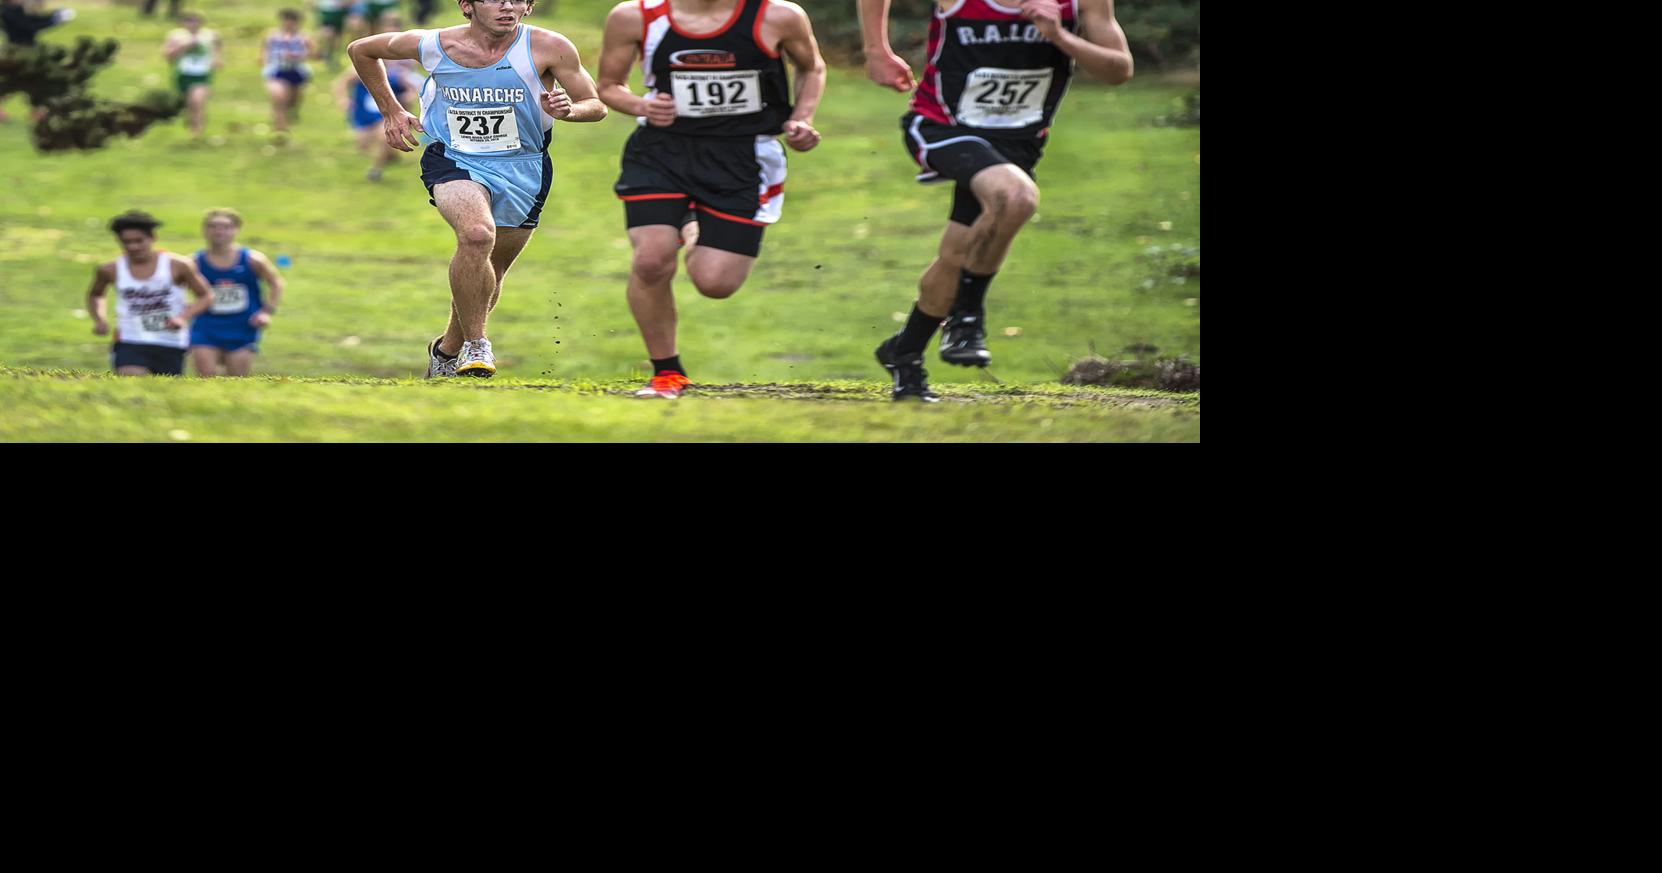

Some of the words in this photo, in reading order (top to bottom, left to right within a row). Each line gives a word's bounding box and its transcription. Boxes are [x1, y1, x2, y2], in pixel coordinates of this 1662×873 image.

[957, 24, 1051, 45] R.A.LO
[442, 87, 524, 103] MONARCHS
[686, 81, 748, 106] 192
[975, 80, 1040, 105] 257
[456, 116, 505, 136] 237
